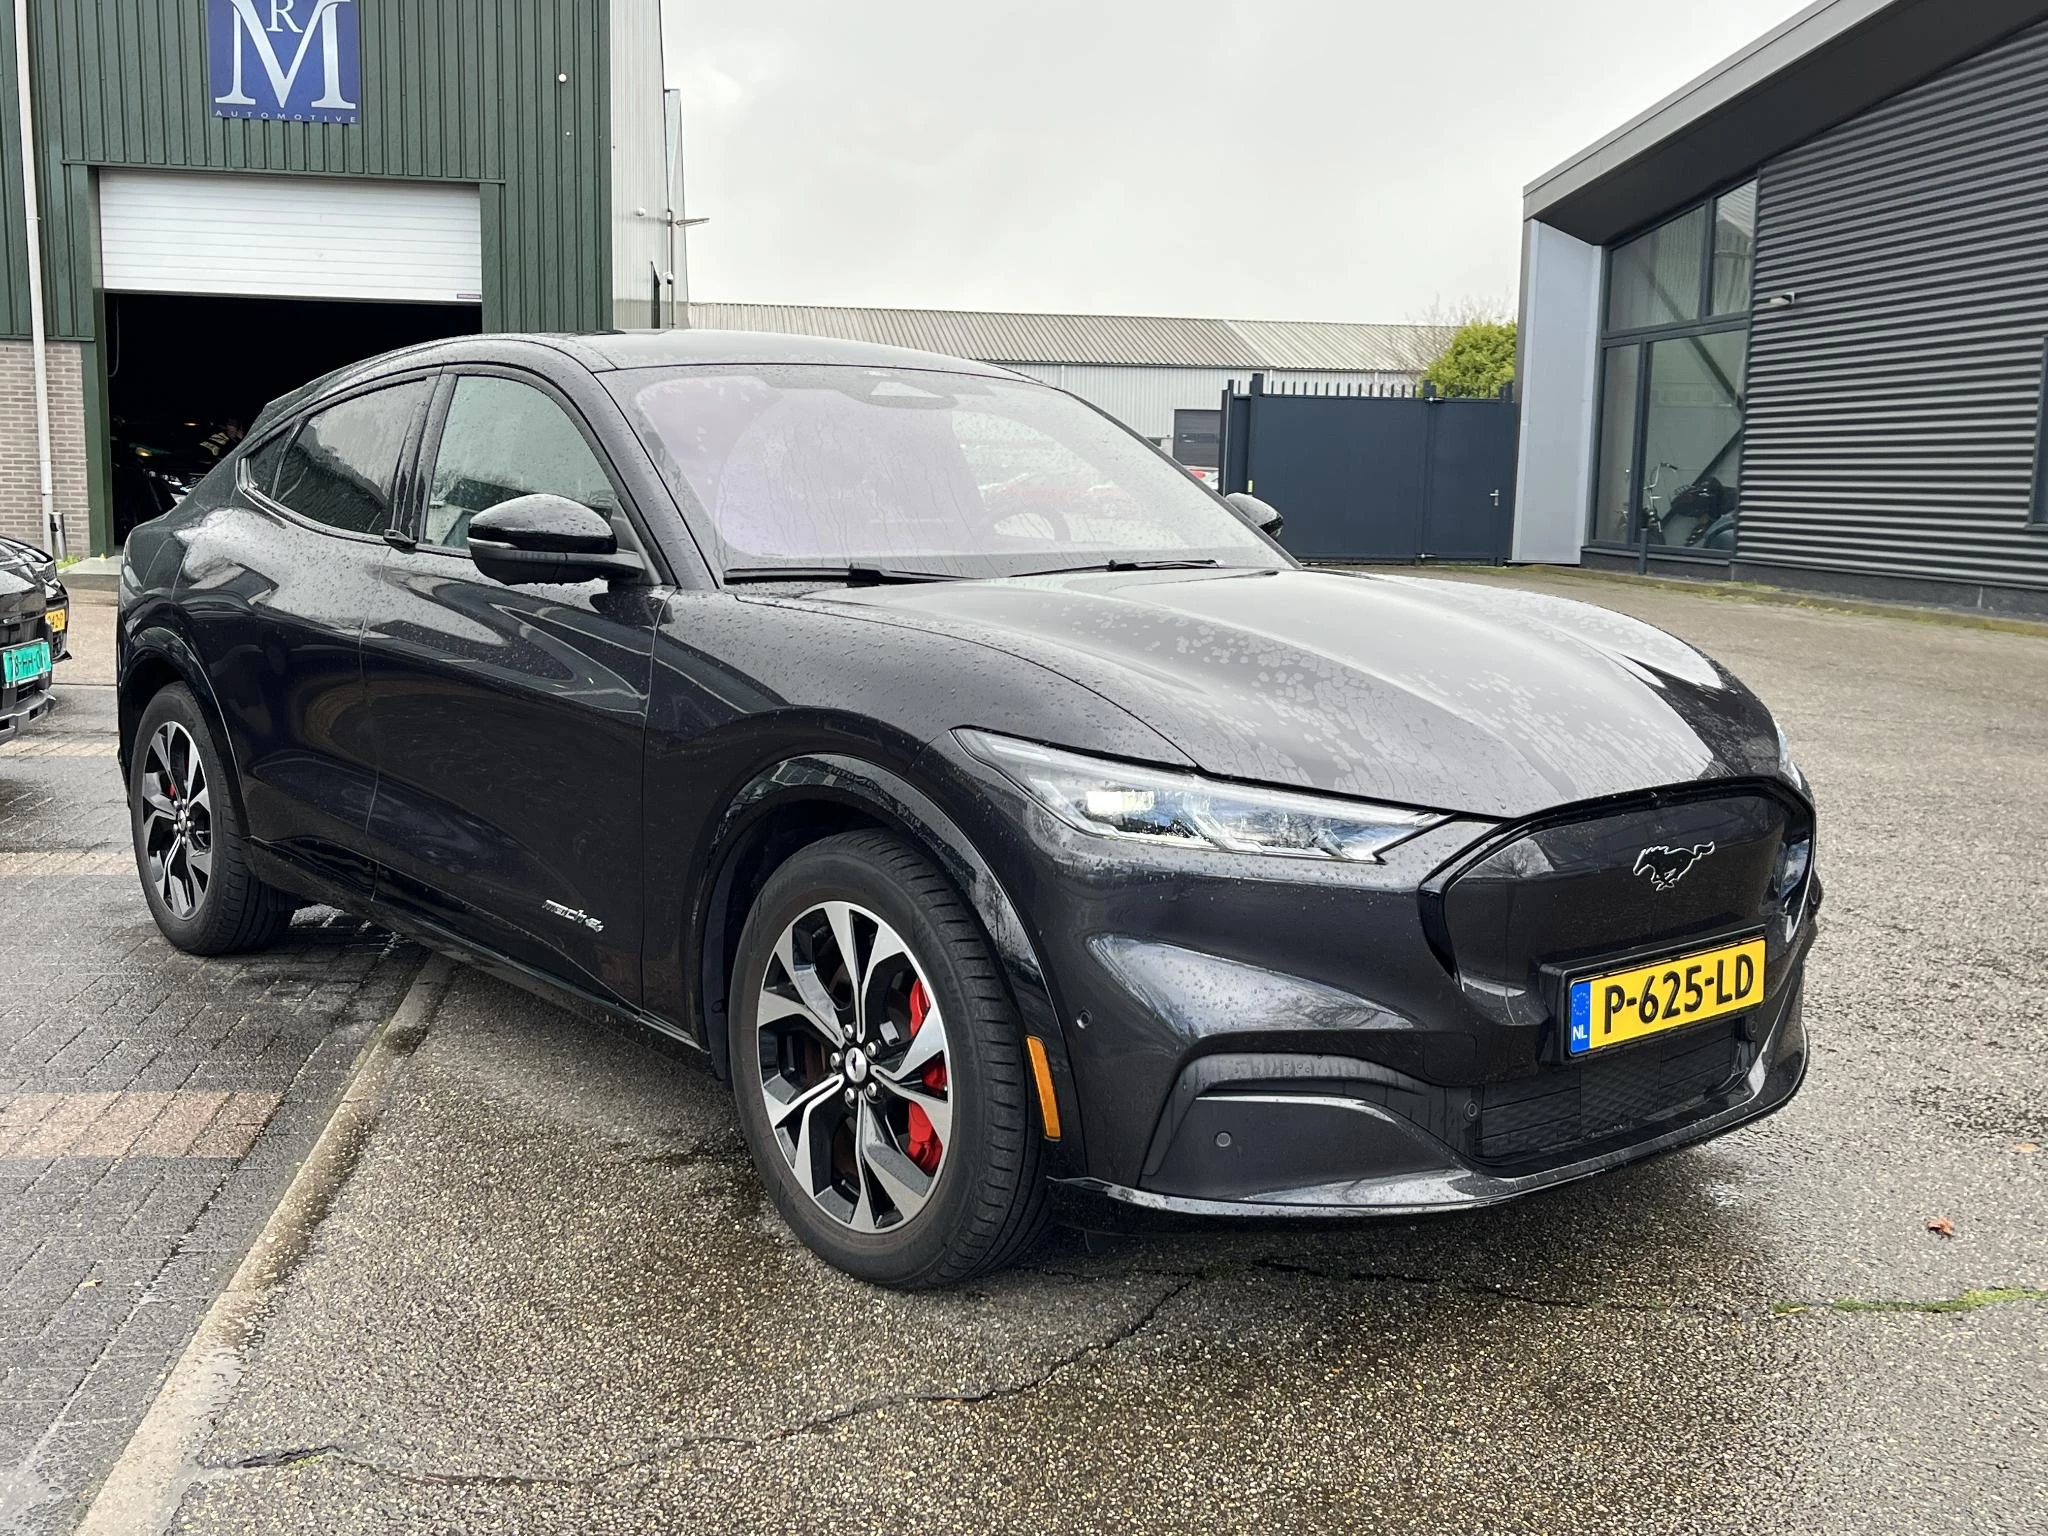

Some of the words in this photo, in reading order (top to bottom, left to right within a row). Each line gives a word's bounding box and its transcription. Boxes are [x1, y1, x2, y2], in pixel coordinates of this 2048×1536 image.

[215, 109, 357, 124] AUTOMOTIVE
[1604, 953, 1754, 1035] P-625-LD
[1572, 1023, 1588, 1041] NL
